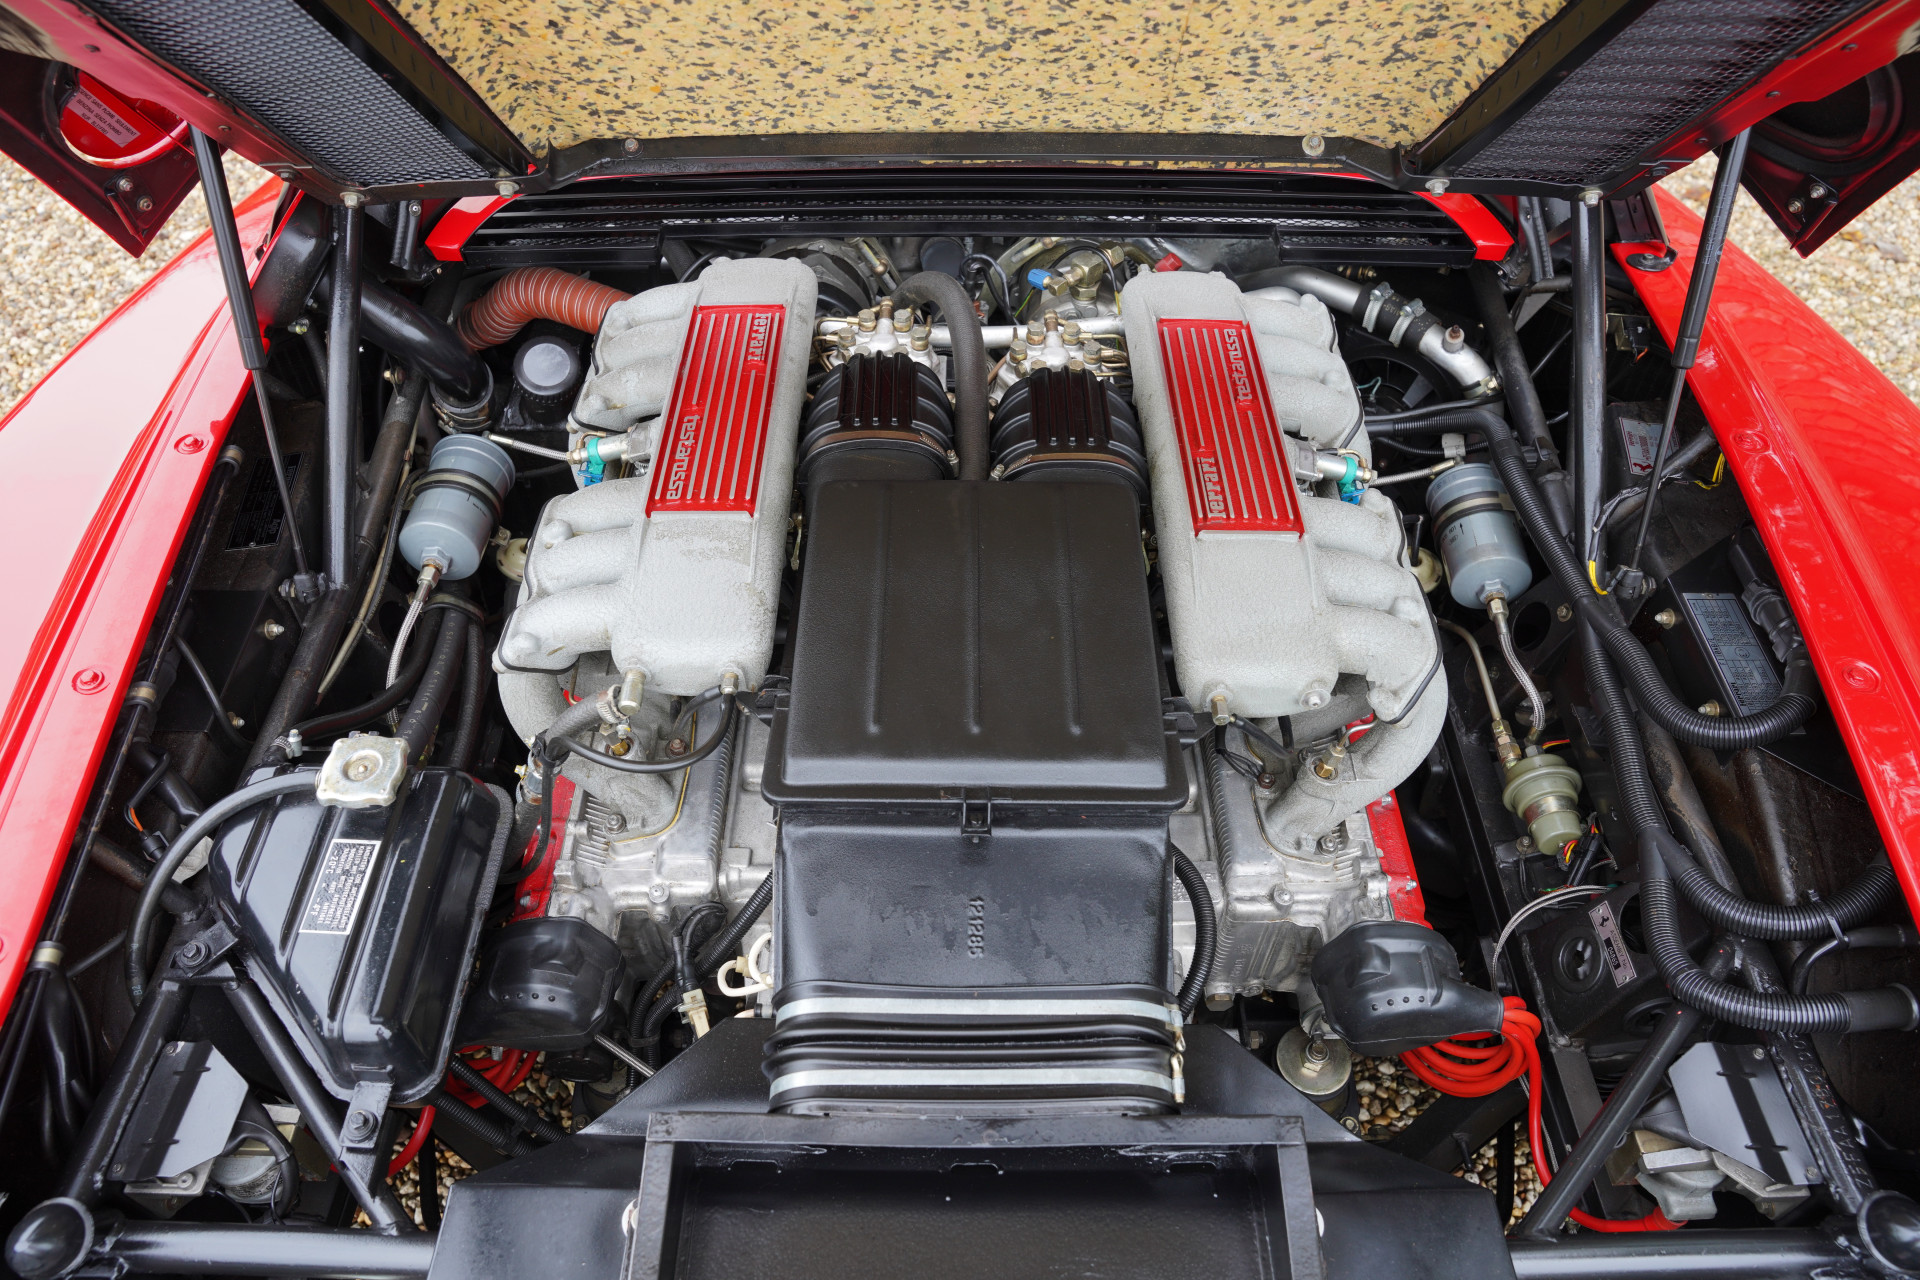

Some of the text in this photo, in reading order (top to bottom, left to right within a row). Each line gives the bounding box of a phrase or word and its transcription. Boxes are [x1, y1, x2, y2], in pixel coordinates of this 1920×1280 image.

[76, 99, 122, 136] BENZINA SENZA PIOMBO
[91, 98, 103, 109] SANS
[115, 119, 137, 136] SEULEMENT
[91, 121, 109, 134] BLEIFREI
[1224, 329, 1252, 400] testarossa
[667, 415, 700, 500] testarossa
[336, 848, 350, 874] RADIATEUR
[344, 848, 356, 870] RADIATOR
[355, 874, 365, 884] CON
